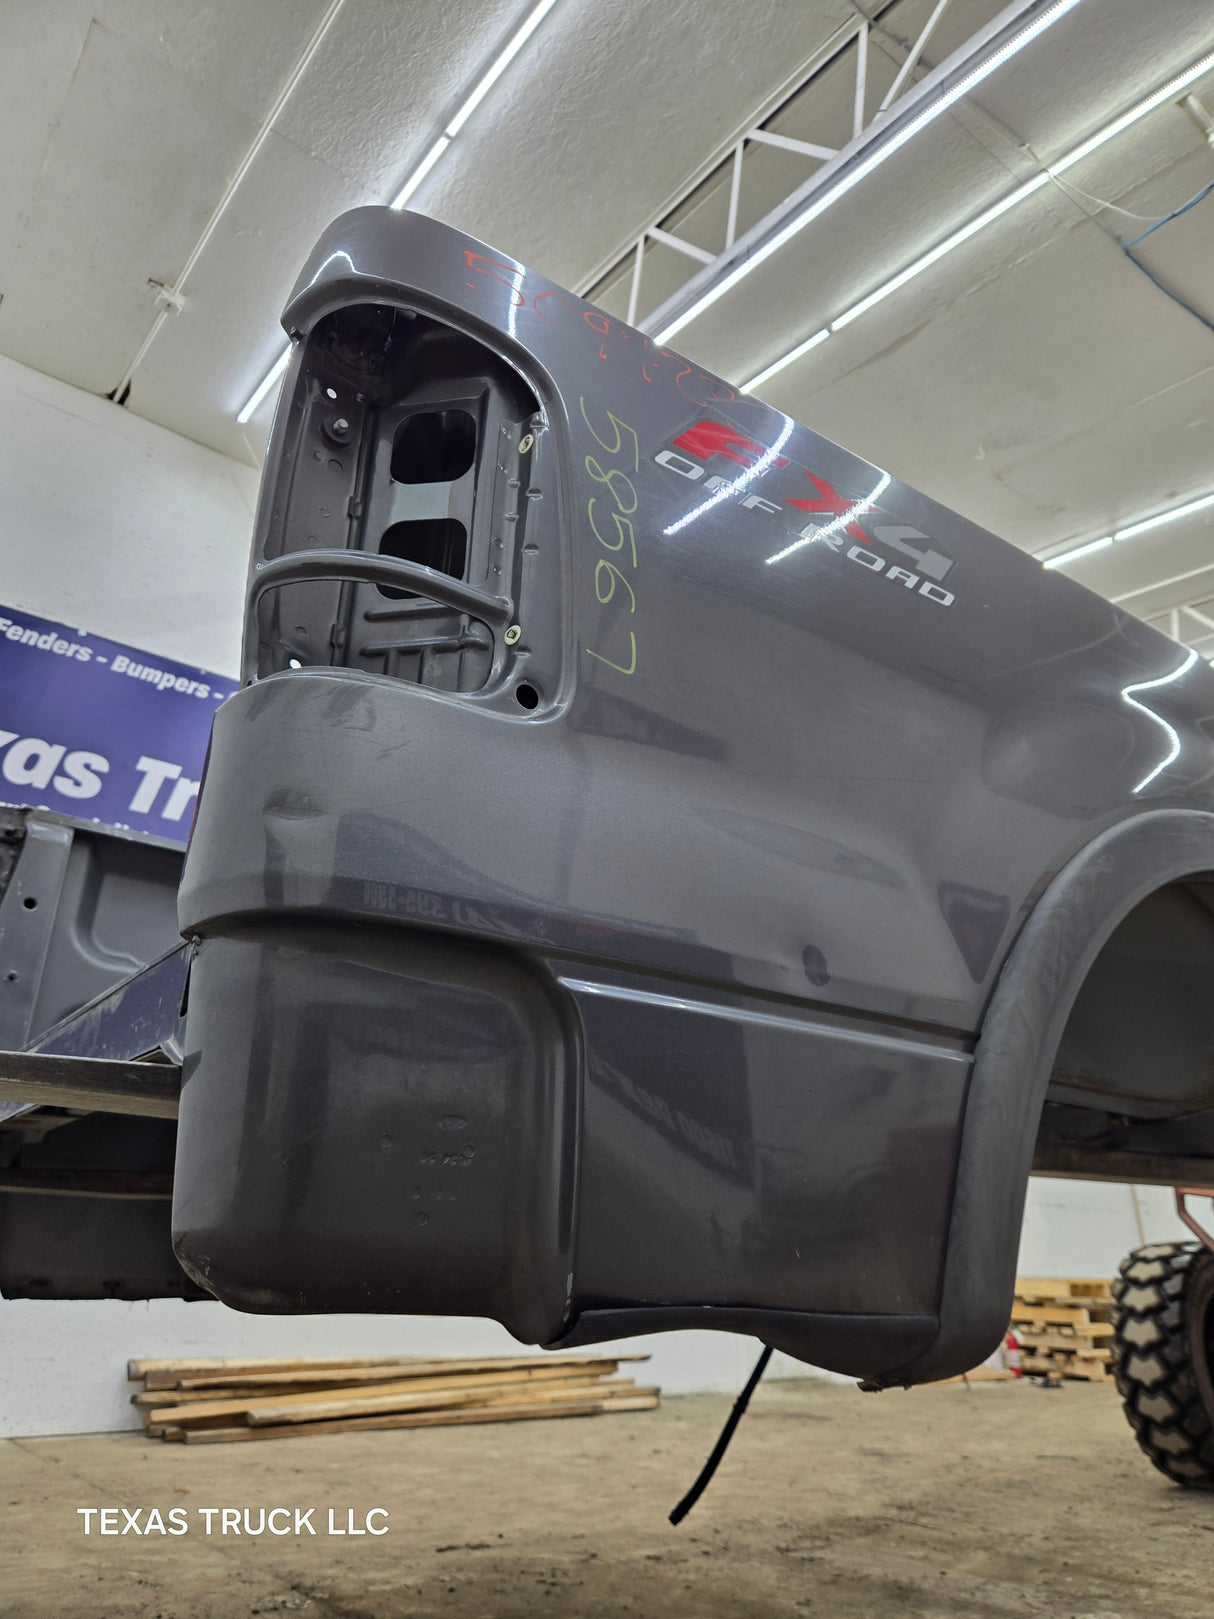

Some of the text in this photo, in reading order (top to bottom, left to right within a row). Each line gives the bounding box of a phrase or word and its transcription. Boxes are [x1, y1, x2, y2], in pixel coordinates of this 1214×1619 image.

[671, 420, 954, 581] FX4
[800, 523, 955, 606] ROAD
[110, 654, 211, 698] Bumpers
